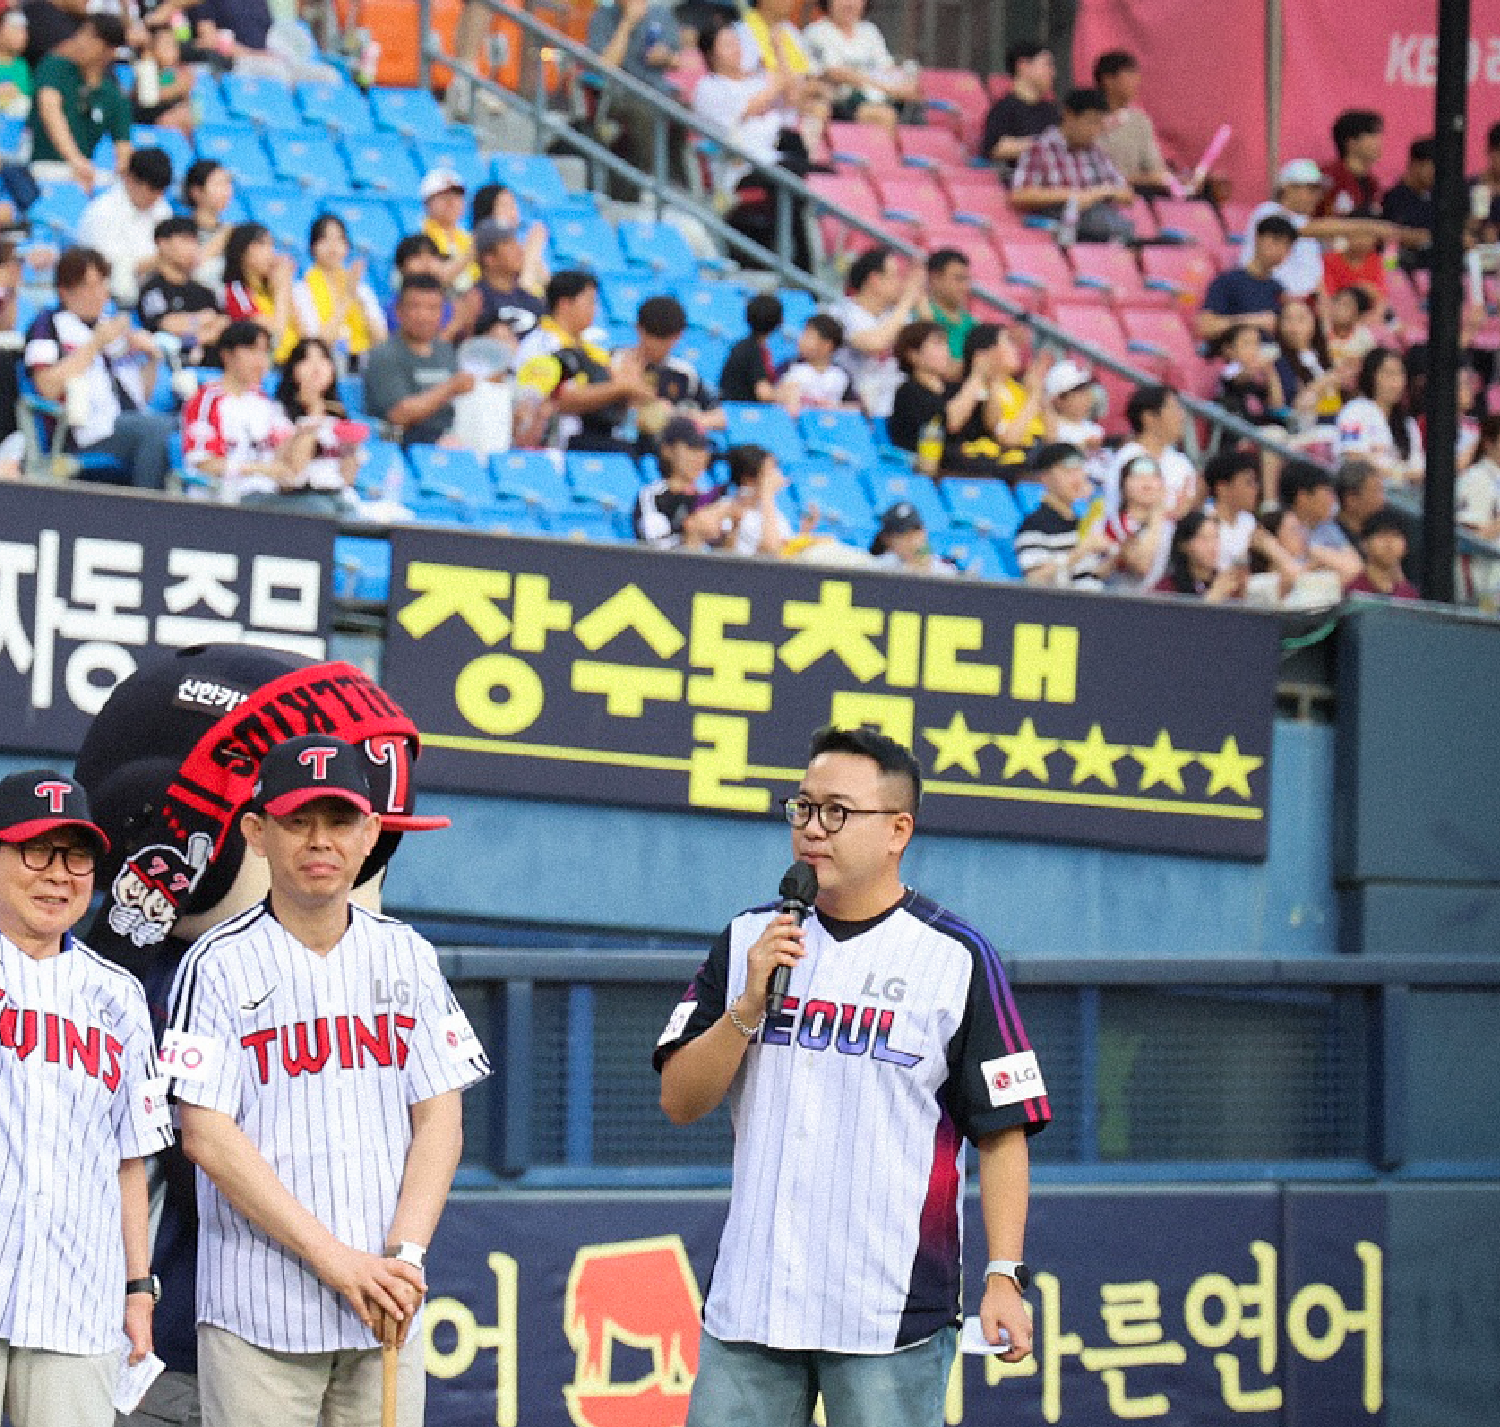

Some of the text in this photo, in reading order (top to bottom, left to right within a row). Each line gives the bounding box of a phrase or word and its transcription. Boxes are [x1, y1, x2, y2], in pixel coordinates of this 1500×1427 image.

[396, 552, 1079, 814] 장수돌침대
[298, 746, 337, 780] T
[34, 779, 73, 813] T
[375, 979, 411, 1006] LG
[860, 971, 907, 1003] LG
[240, 1013, 417, 1085] TWINS
[747, 995, 925, 1069] EOUL
[1013, 1066, 1038, 1085] LG
[812, 1239, 1384, 1427] 바른연어
